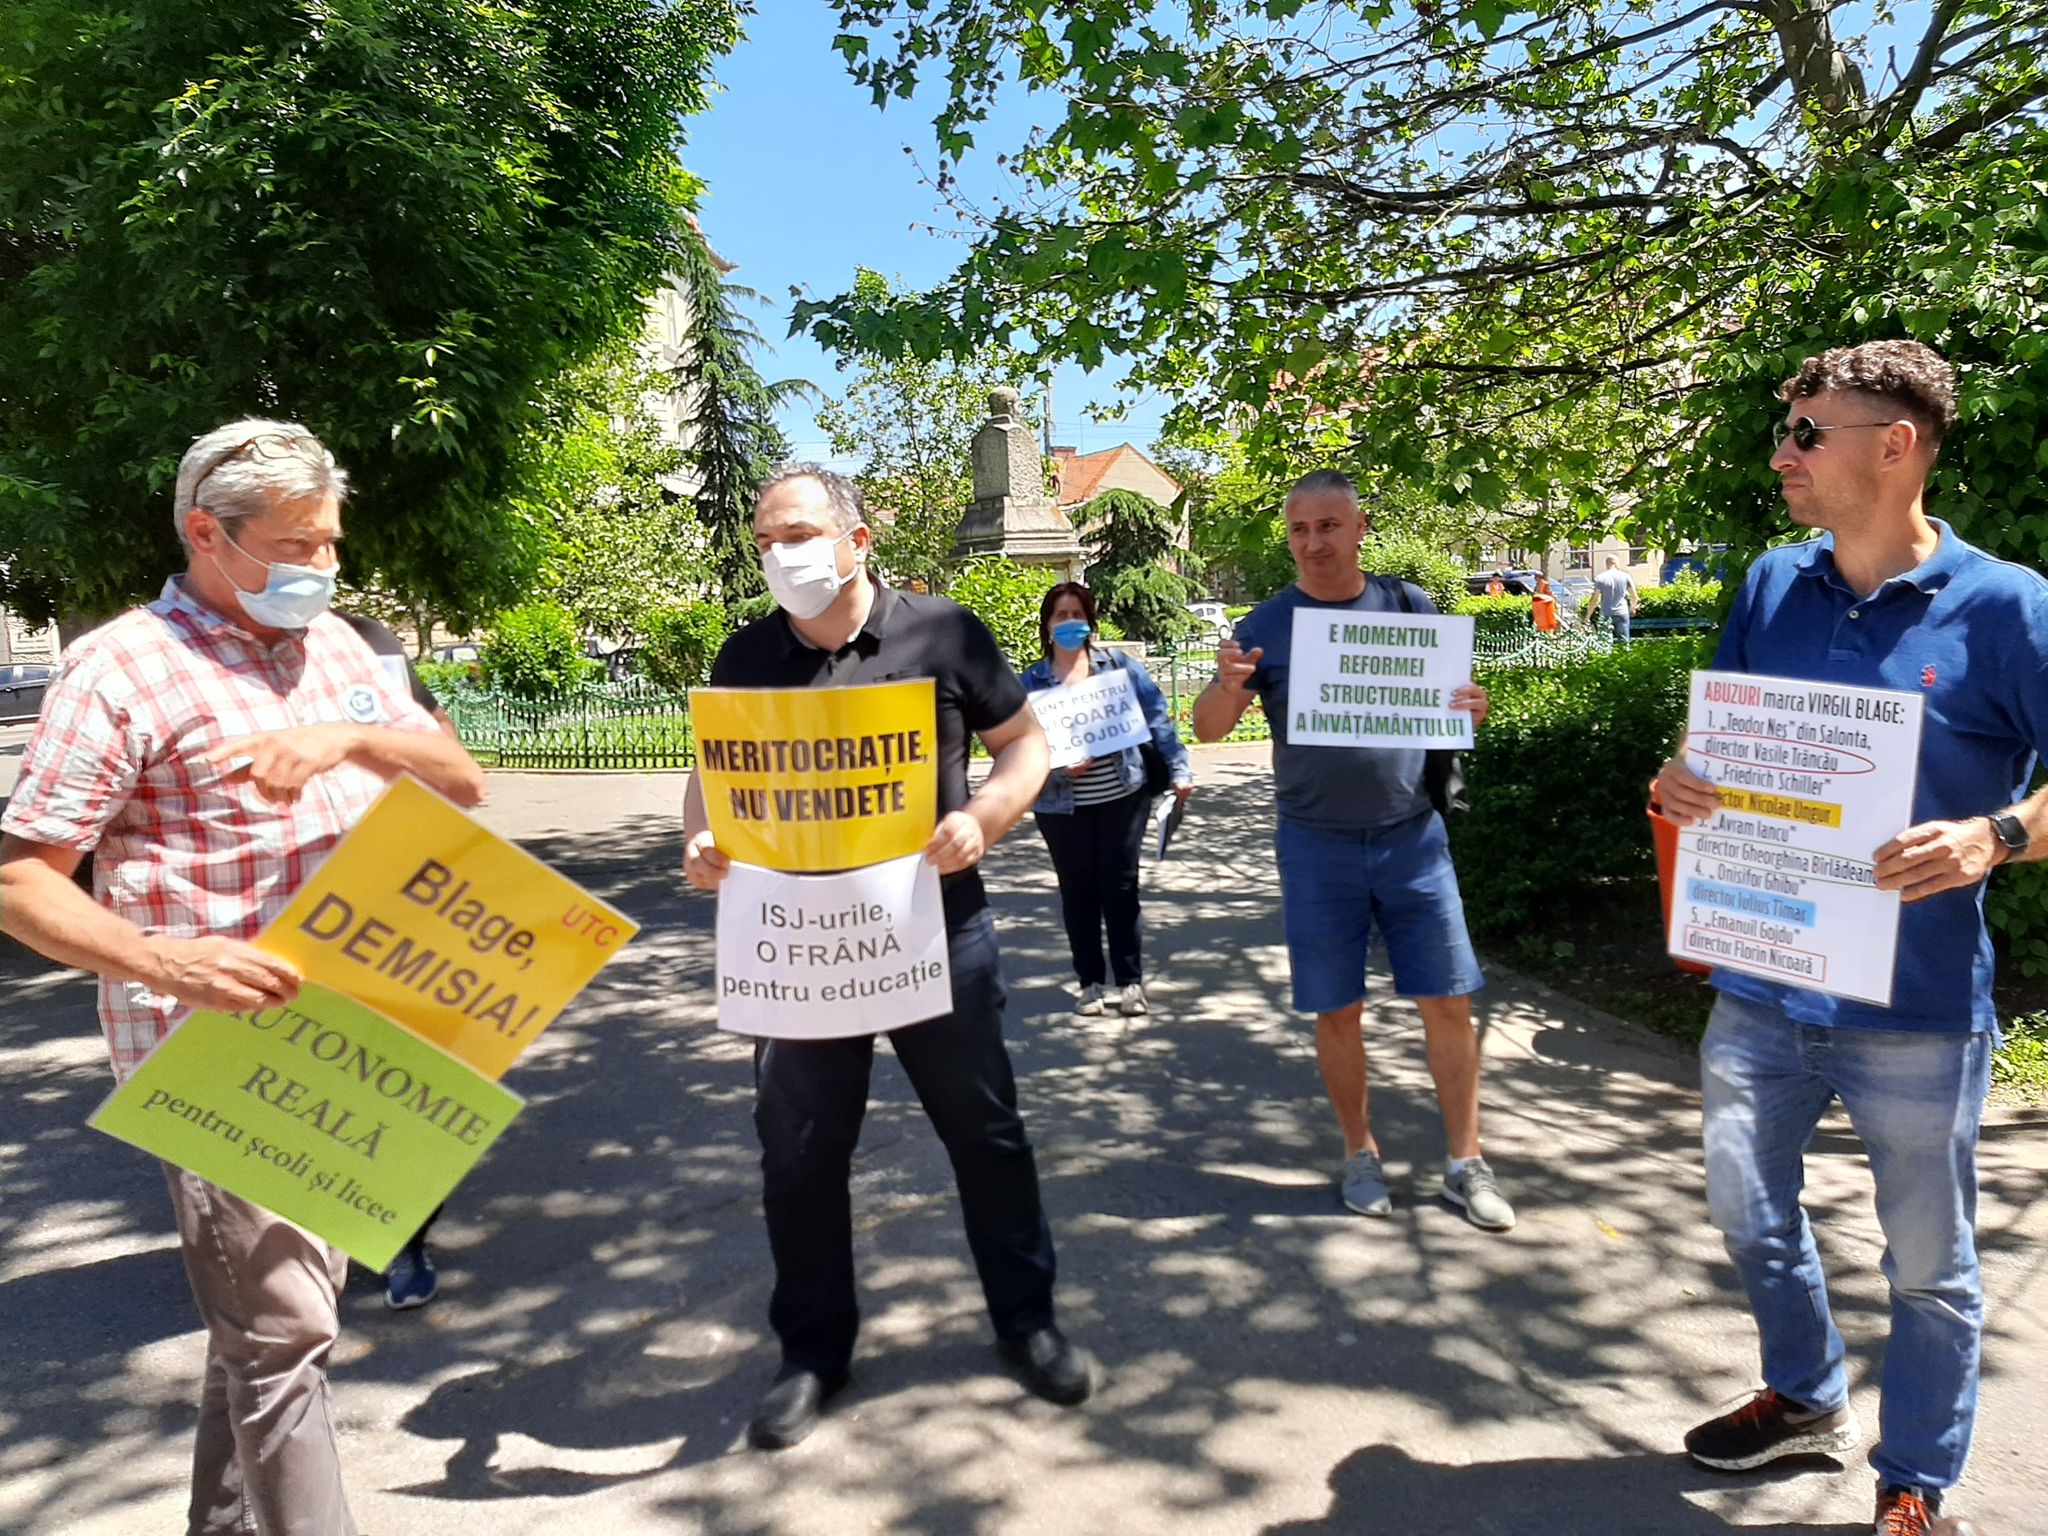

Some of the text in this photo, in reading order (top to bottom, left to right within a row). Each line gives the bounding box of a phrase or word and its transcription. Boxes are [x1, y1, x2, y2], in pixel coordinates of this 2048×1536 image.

[1329, 624, 1439, 648] E MOMENTUL
[1339, 654, 1425, 677] REFORMEI
[1072, 684, 1128, 705] PENTRU
[1320, 683, 1441, 707] STRUCTURALE
[1704, 681, 1905, 724] ABUZURI marca VIRGIL BLAGE:
[1296, 712, 1306, 731] A
[1708, 710, 1716, 728] 1.
[1797, 721, 1817, 743] din
[1819, 724, 1872, 751] Salonta,
[703, 730, 929, 777] MERITOCRAȚIE,
[1705, 737, 1749, 758] director
[1754, 742, 1788, 765] Vasile
[730, 780, 905, 822] NU VENDETE
[1750, 793, 1790, 818] Nicolae
[1697, 836, 1740, 857] director
[1742, 842, 1809, 871] Gheorghina
[400, 858, 539, 972] Blage,
[762, 901, 892, 931] ISJ-urile,
[1692, 884, 1736, 908] director
[1738, 892, 1770, 914] Iulius
[561, 904, 618, 949] UTC
[757, 927, 901, 966] O FRÂNĂ
[299, 892, 542, 1040] DEMISIA!
[1689, 931, 1813, 975] director Florin Nicoară
[722, 960, 943, 1001] pentru educație
[230, 1006, 490, 1147] UTONOMIE
[238, 1062, 390, 1160] REALĂ
[142, 1088, 244, 1143] pentru
[243, 1137, 314, 1178] școli
[335, 1178, 397, 1225] licee
